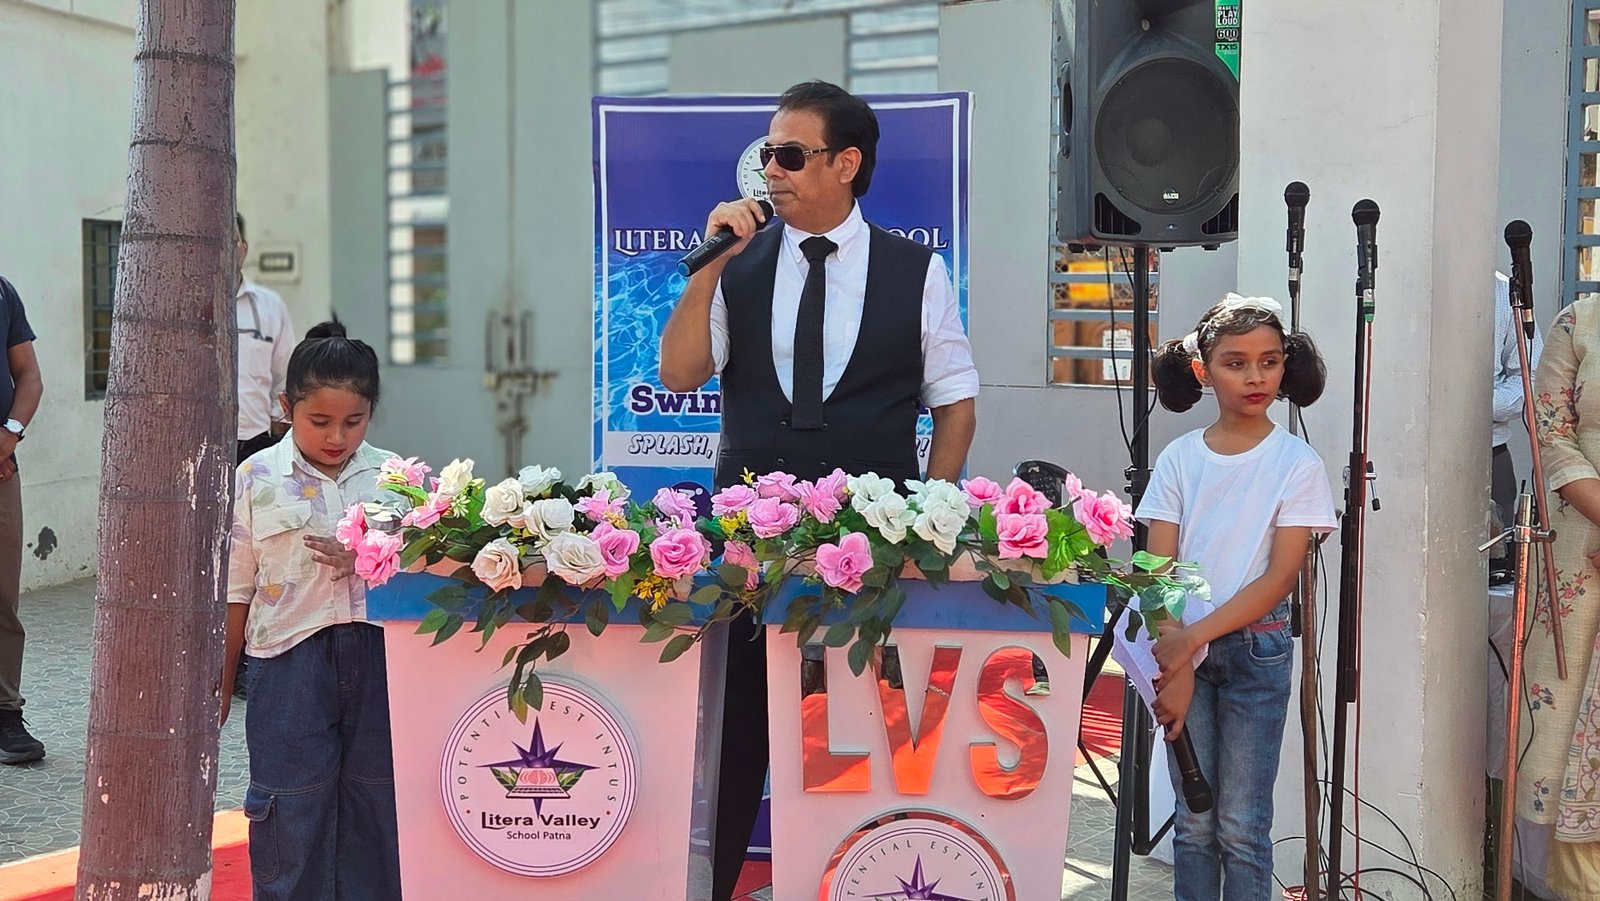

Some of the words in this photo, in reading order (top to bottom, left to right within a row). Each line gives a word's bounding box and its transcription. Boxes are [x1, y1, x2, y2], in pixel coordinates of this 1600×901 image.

[1217, 28, 1238, 39] 600
[1217, 43, 1238, 51] TX15
[614, 228, 703, 256] LITERA
[628, 433, 714, 460] SPLASH,
[800, 644, 1050, 801] LVS
[549, 701, 585, 722] EST
[595, 733, 619, 803] INTUS
[481, 811, 534, 831] Litera
[540, 813, 601, 830] Valley
[506, 831, 540, 841] School
[542, 831, 572, 841] Patna
[847, 839, 912, 897] TENTIAL
[930, 841, 962, 861] EST
